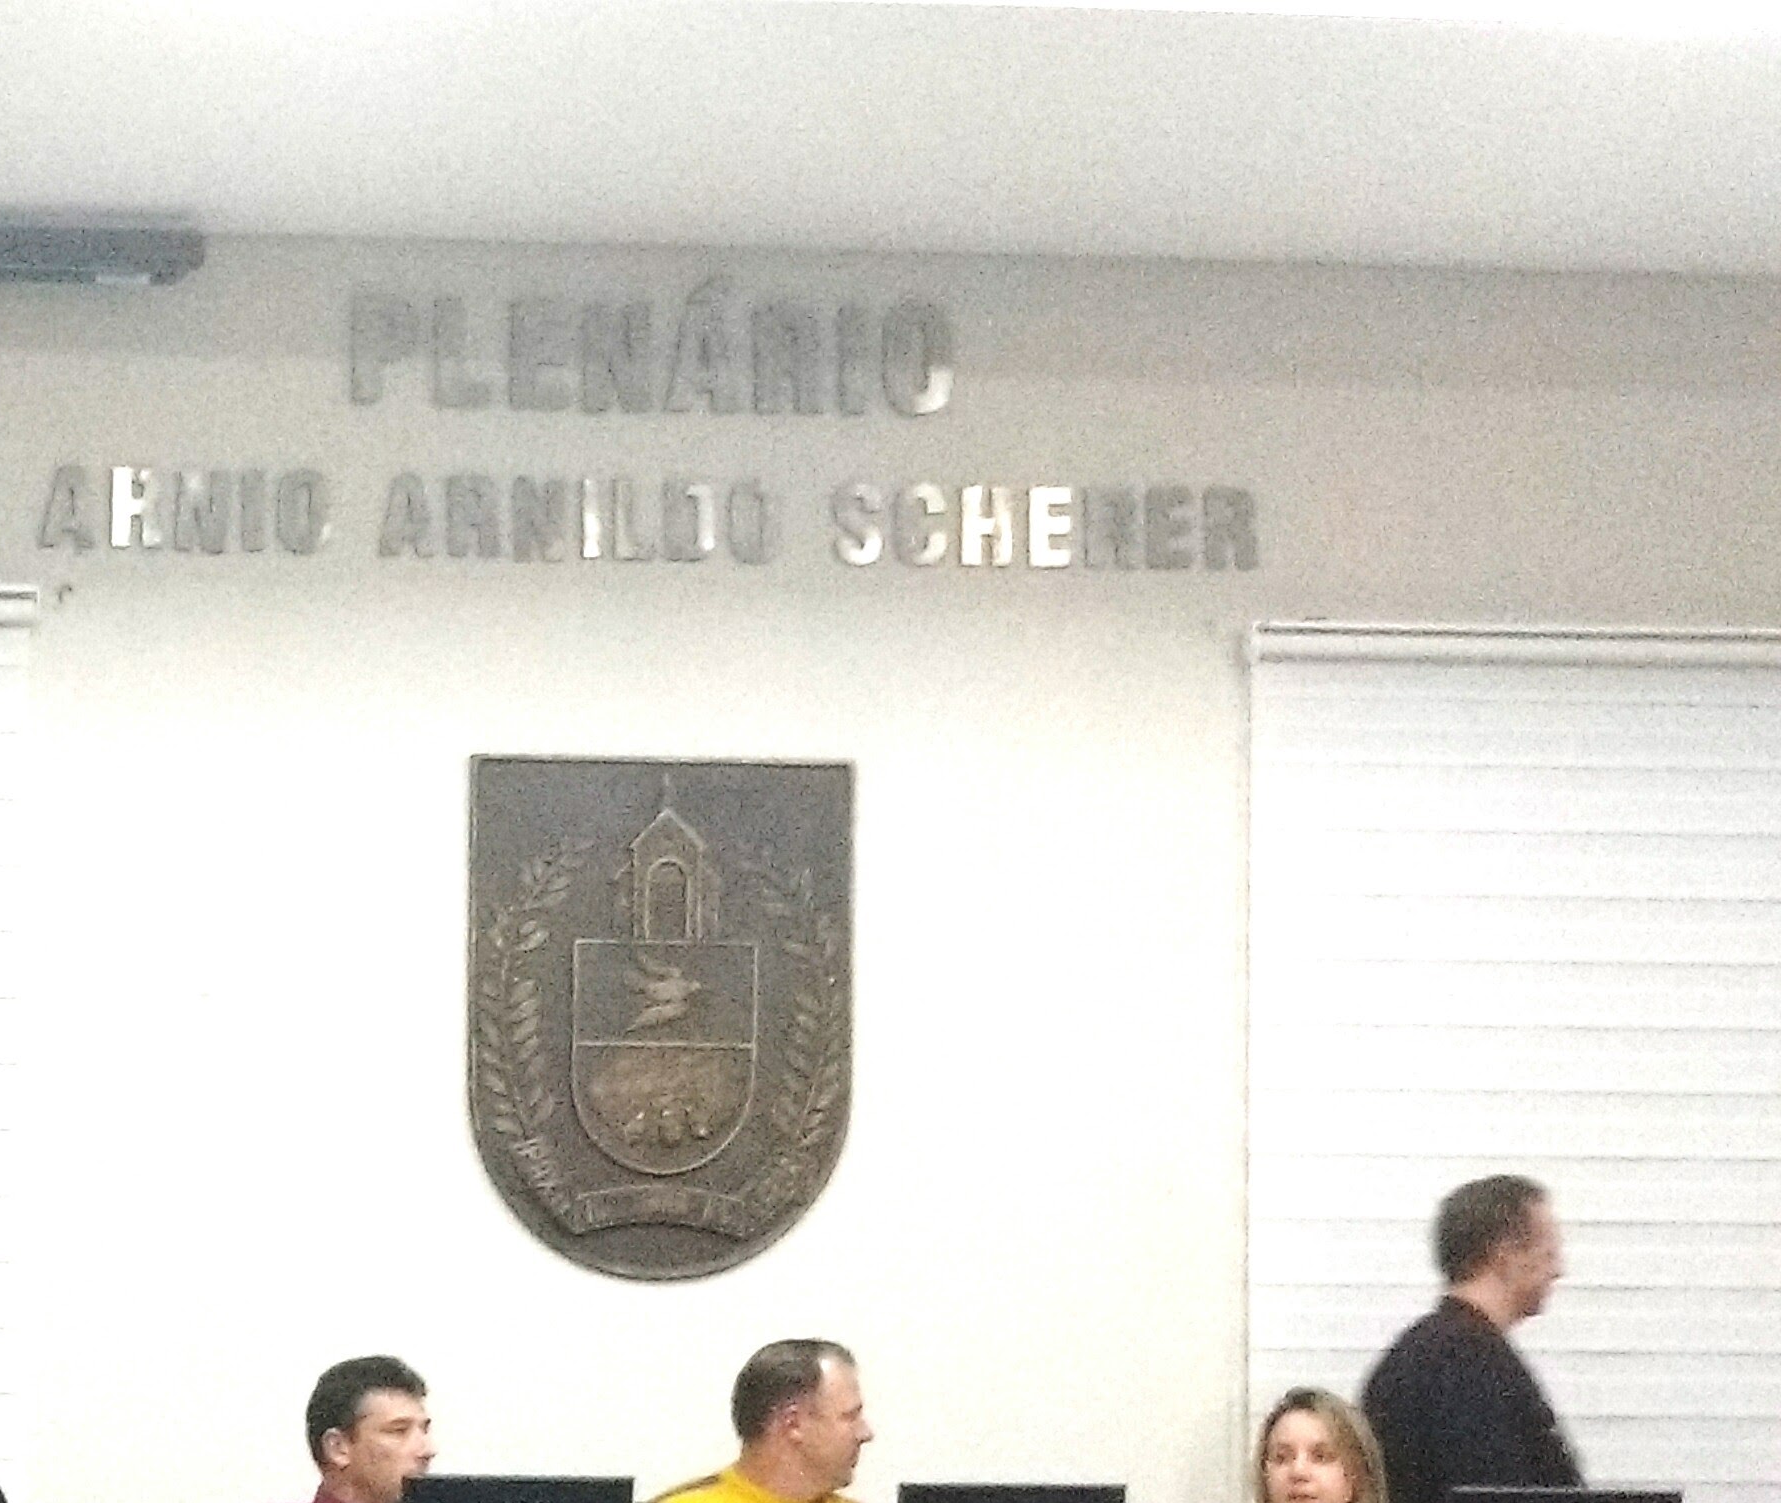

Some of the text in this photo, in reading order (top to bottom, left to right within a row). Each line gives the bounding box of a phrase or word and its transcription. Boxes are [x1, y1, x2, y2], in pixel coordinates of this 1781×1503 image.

[348, 275, 956, 417] PLENÁRIO
[38, 464, 1259, 569] ARNIO ARNILDO SCHERER
